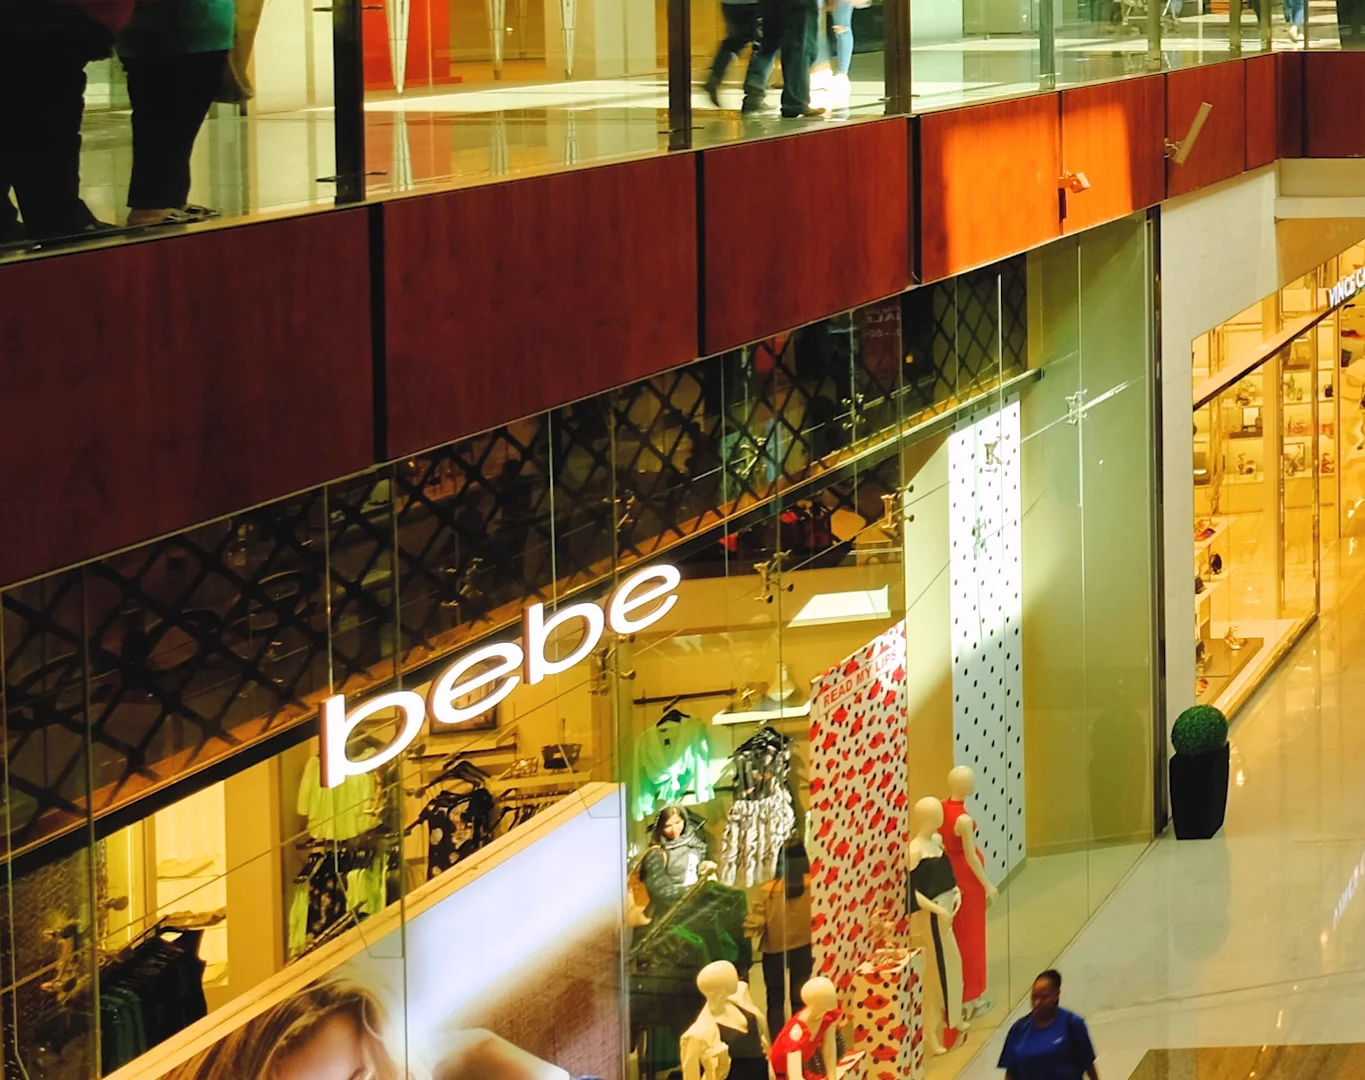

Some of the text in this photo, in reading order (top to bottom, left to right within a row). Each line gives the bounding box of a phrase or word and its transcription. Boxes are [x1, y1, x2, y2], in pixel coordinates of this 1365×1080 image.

[1328, 272, 1356, 308] VINCE
[318, 563, 682, 789] bebe
[823, 650, 897, 708] READ MY LIPS
